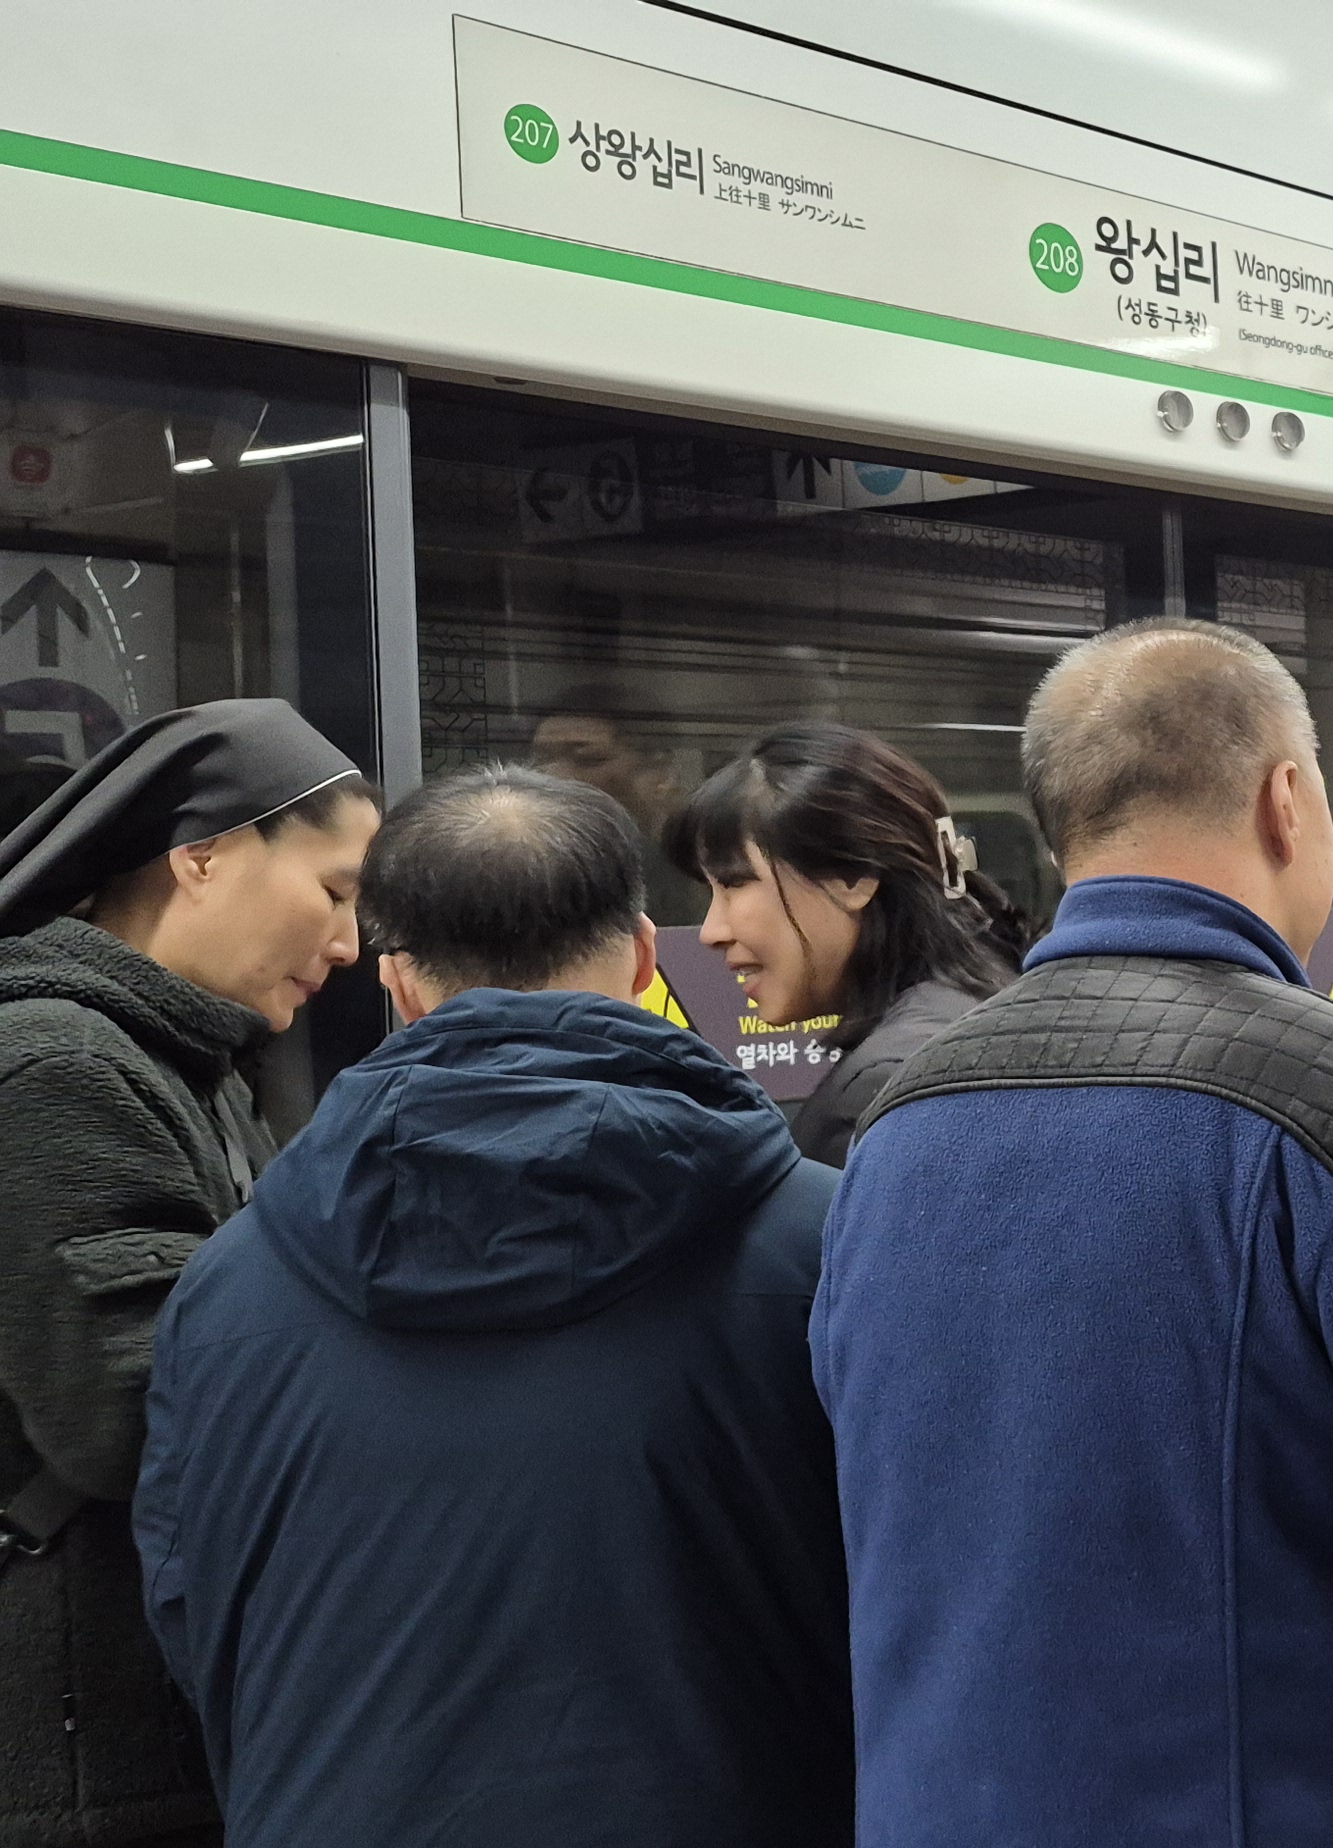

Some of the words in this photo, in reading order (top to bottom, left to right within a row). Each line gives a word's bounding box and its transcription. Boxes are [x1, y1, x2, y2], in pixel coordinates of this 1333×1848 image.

[510, 115, 553, 149] 207
[568, 119, 705, 195] 상왕십리
[713, 153, 834, 200] Sangwangsimni
[714, 182, 771, 212] 上往十里
[778, 198, 866, 230] サンワンシムニ
[1034, 237, 1080, 277] 208
[1095, 216, 1220, 304] 왕십리
[1117, 294, 1207, 337] (성동구청)
[1237, 290, 1285, 320] 往十里
[802, 1014, 842, 1034] your
[736, 1039, 799, 1070] 열차와
